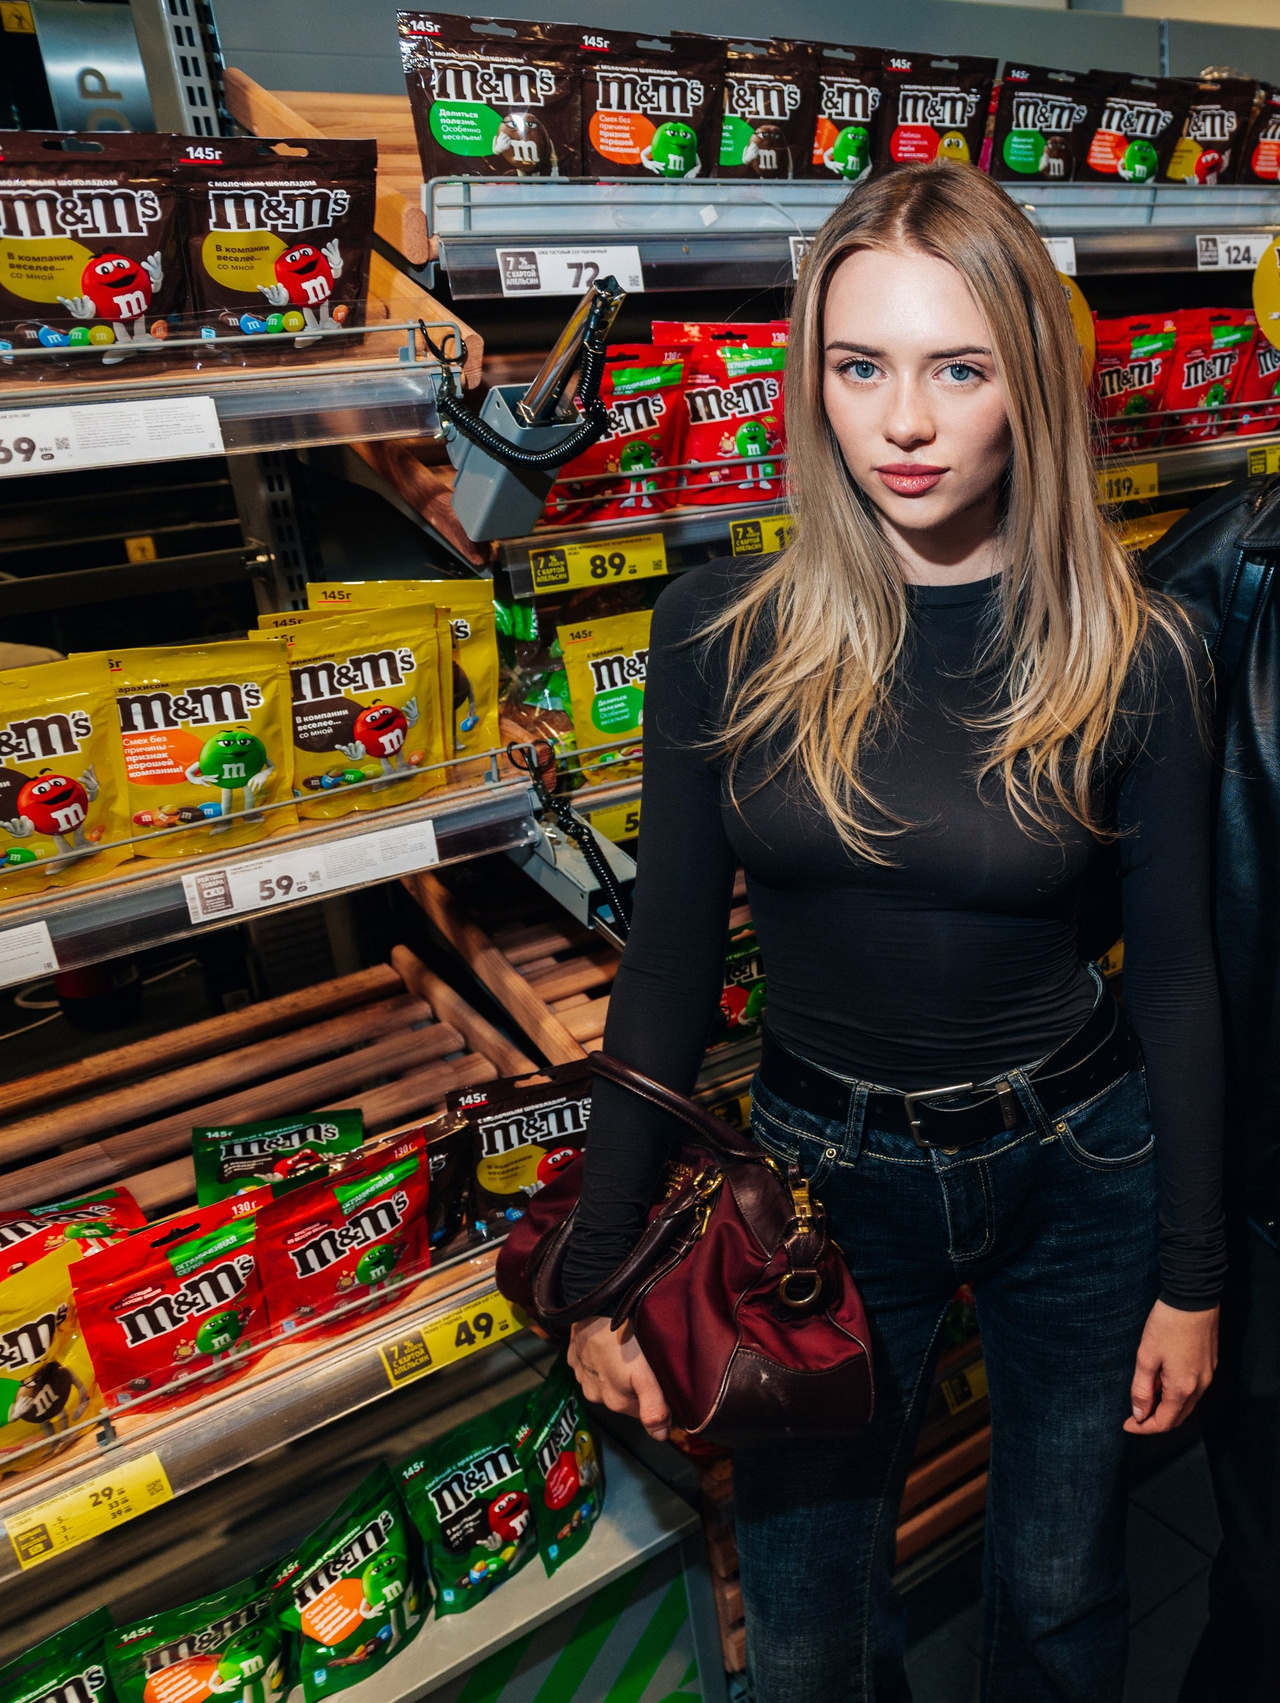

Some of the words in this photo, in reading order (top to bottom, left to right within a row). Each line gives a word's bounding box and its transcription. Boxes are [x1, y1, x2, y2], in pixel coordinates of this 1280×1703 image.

[409, 20, 441, 33] 145г
[582, 35, 610, 48] 145г
[890, 58, 912, 69] 145г
[430, 59, 556, 106] m&m's
[596, 72, 704, 116] m&m's
[819, 81, 881, 121] &m's
[439, 109, 478, 118] Делиться
[1012, 97, 1087, 131] m&m's
[1101, 103, 1173, 138] m&m's
[441, 125, 481, 133] Особенно
[186, 147, 222, 161] 145г
[57, 178, 118, 188] шоколадом
[208, 189, 350, 232] m&m's
[7, 252, 15, 260] В
[18, 254, 74, 262] компании
[215, 244, 222, 252] В
[225, 244, 270, 254] компании
[1225, 245, 1251, 264] 124
[9, 262, 65, 272] веселее...
[231, 262, 255, 271] мной
[506, 257, 514, 270] 7
[26, 272, 54, 281] мной
[512, 269, 536, 278] КАРТОЙ
[567, 262, 600, 288] 72
[301, 275, 332, 304] m
[112, 290, 148, 319] m
[1182, 350, 1238, 390] m&m's
[685, 378, 780, 425] m&m's
[596, 394, 666, 443] &m's
[736, 527, 743, 539] 7
[537, 557, 544, 568] 7
[590, 552, 626, 579] 89
[537, 573, 567, 583] АПЕЛЬСИН
[541, 566, 565, 576] КАРТОЙ
[322, 590, 352, 601] 145г
[569, 630, 593, 641] 145г
[291, 647, 416, 705] m&m's
[118, 682, 169, 693] арахисом
[116, 682, 264, 733] m&m's
[296, 715, 302, 724] В
[303, 709, 348, 722] компании
[0, 711, 92, 766] &m's
[310, 727, 333, 738] мной
[123, 735, 148, 748] Смех
[150, 734, 167, 744] без
[124, 743, 167, 755] причины
[379, 729, 404, 755] m
[126, 751, 169, 763] признак
[127, 759, 174, 771] хорошей
[128, 765, 183, 779] компании!
[222, 763, 246, 779] m
[50, 803, 86, 831] m
[202, 880, 225, 889] ТОВАРА
[260, 875, 294, 901] 59
[459, 1093, 487, 1106] 145г
[206, 1131, 233, 1139] 145г
[220, 1124, 339, 1161] m&m's
[288, 1190, 409, 1279] m&m's
[115, 1254, 255, 1348] m&m's
[0, 1303, 68, 1371] &m's
[455, 1312, 493, 1347] 49
[390, 1346, 398, 1359] 7
[400, 1348, 425, 1365] КАРТОЙ
[394, 1355, 430, 1376] АПЕЛЬСИН
[402, 1460, 426, 1480] 145г
[428, 1443, 522, 1523] m&m
[89, 1486, 114, 1507] 29
[108, 1501, 119, 1510] 33
[110, 1508, 123, 1519] 39
[294, 1510, 393, 1614] m&m's
[382, 1580, 404, 1602] m
[120, 1626, 154, 1642] 145г
[240, 1655, 264, 1678] m
